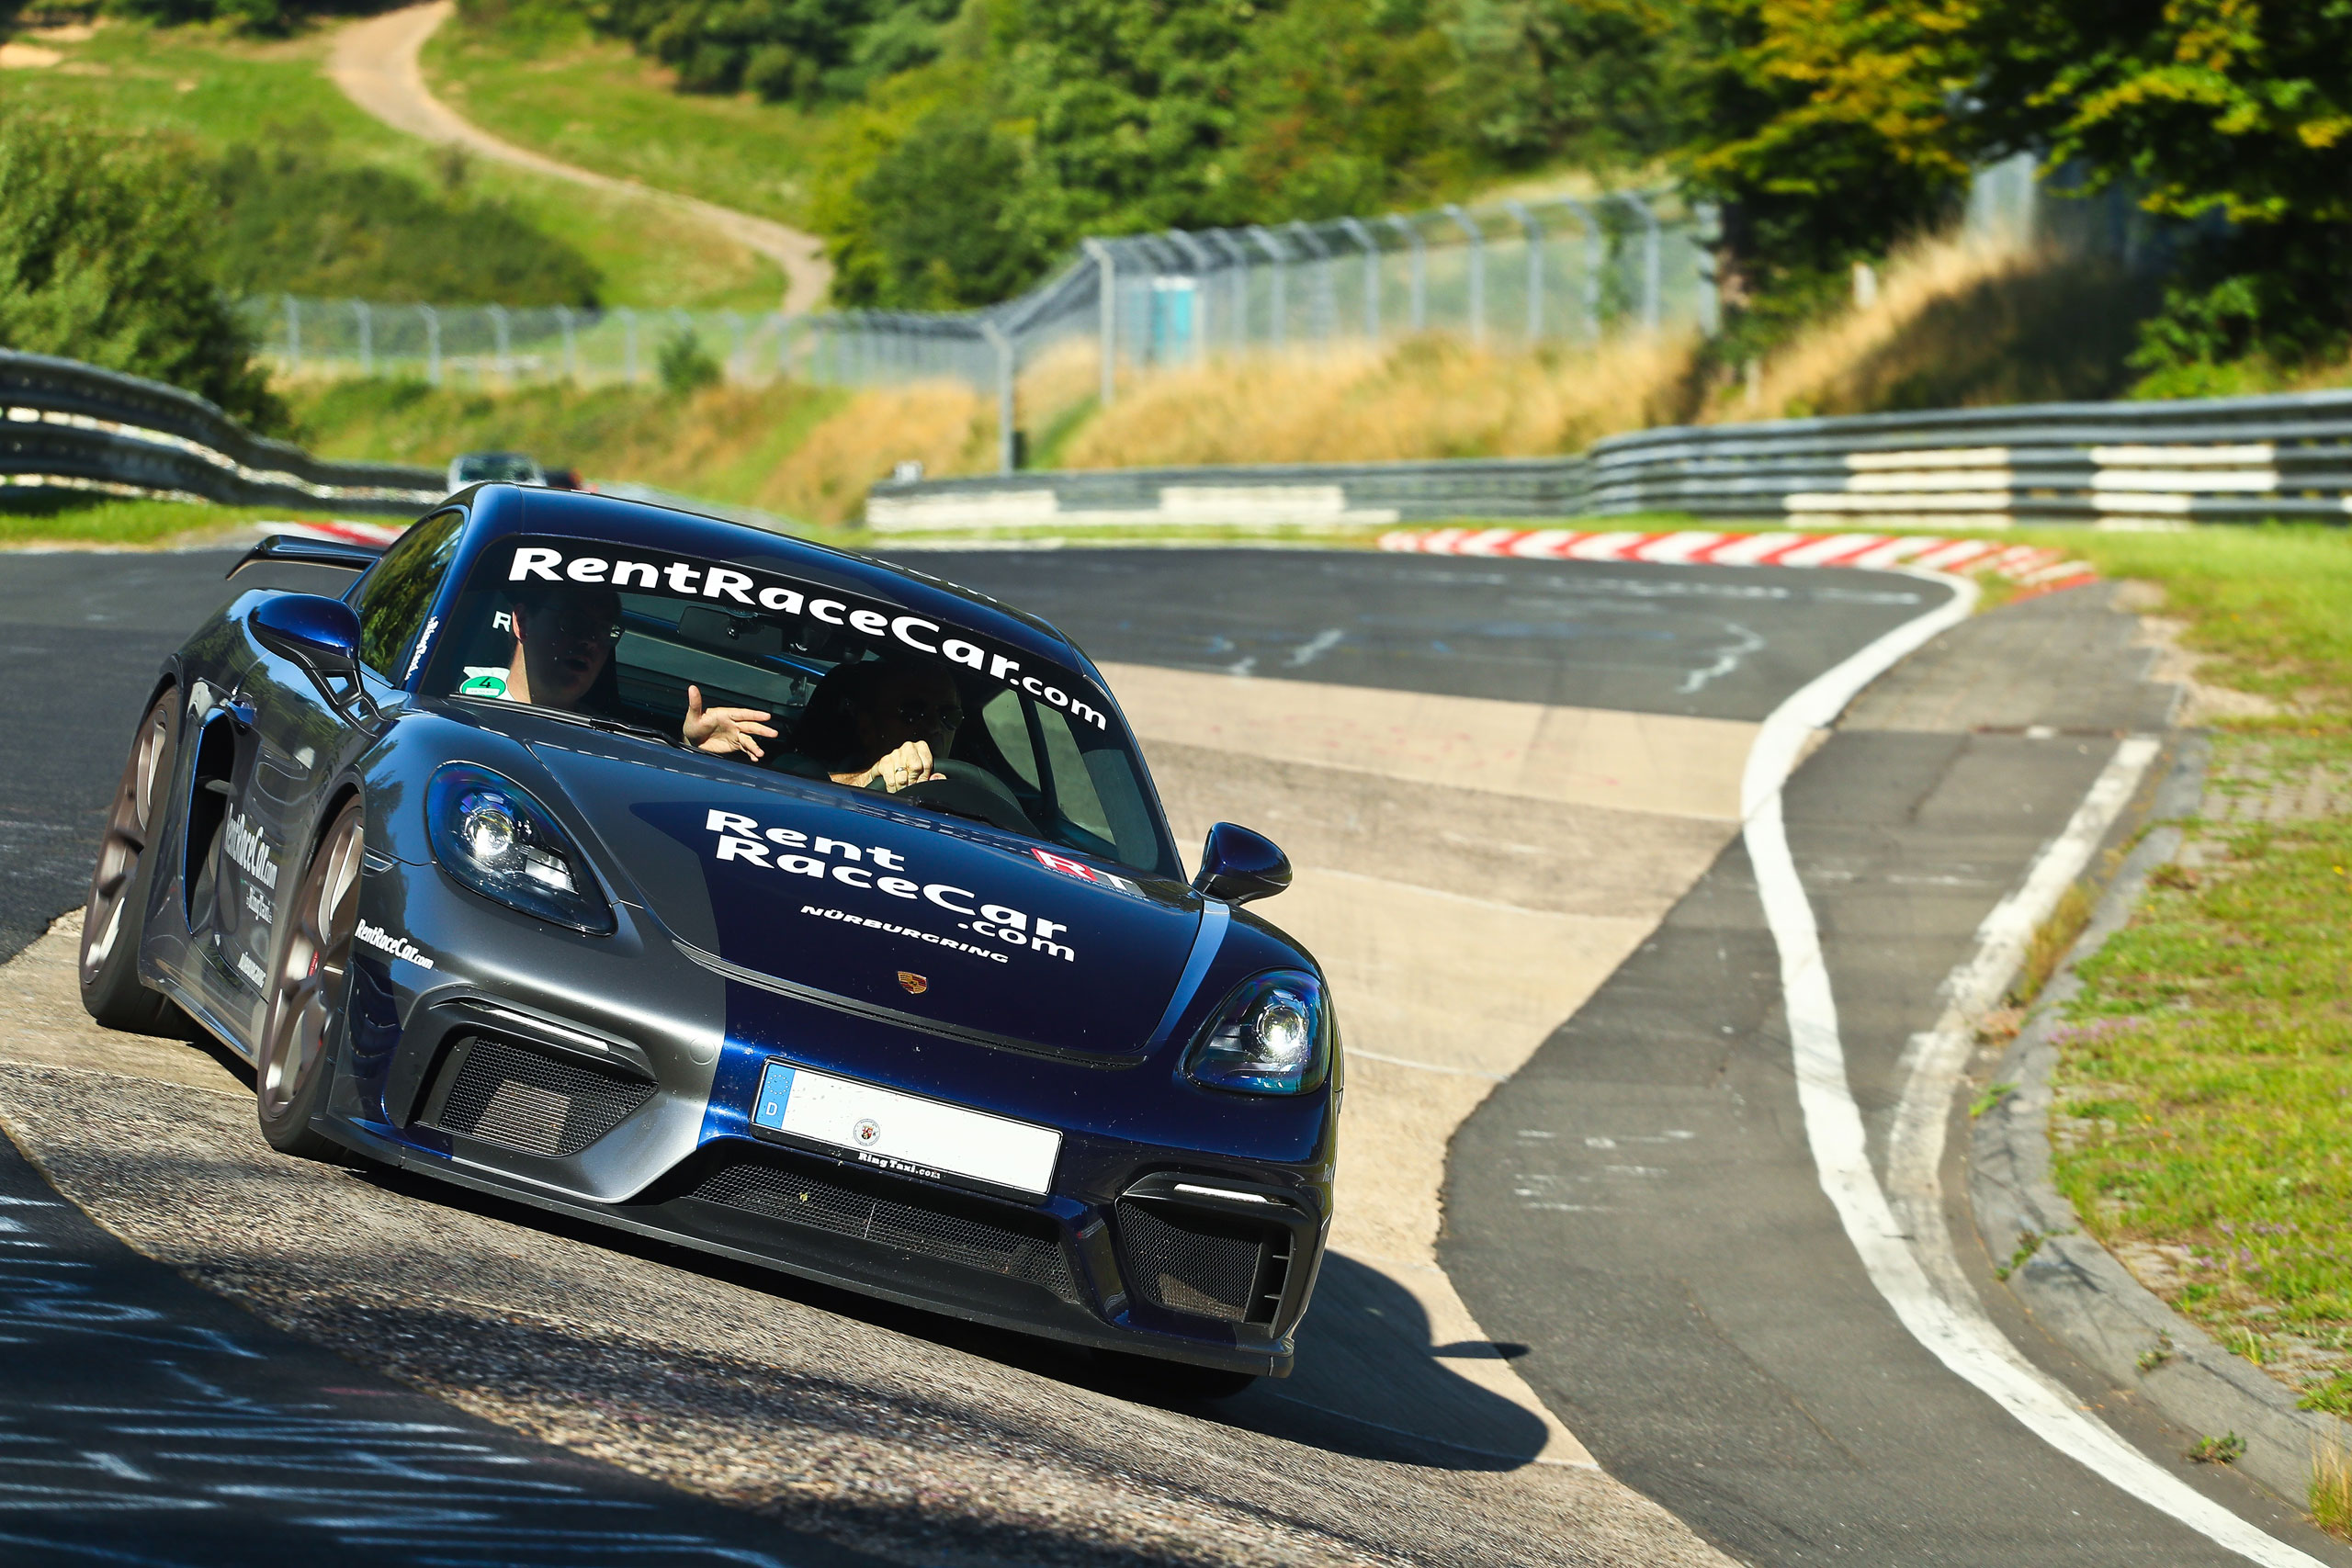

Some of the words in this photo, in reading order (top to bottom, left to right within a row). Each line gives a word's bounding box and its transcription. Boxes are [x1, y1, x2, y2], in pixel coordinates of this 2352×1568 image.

[508, 547, 1107, 731] RentRaceCar.com
[706, 808, 905, 872] Rent
[716, 834, 1068, 940] RaceCar
[354, 918, 435, 970] RentRaceCar.com
[800, 905, 1009, 964] NÜRBURGRING
[957, 920, 1075, 963] .com
[765, 1101, 778, 1116] D
[857, 1152, 942, 1179] RingTaxi.com
